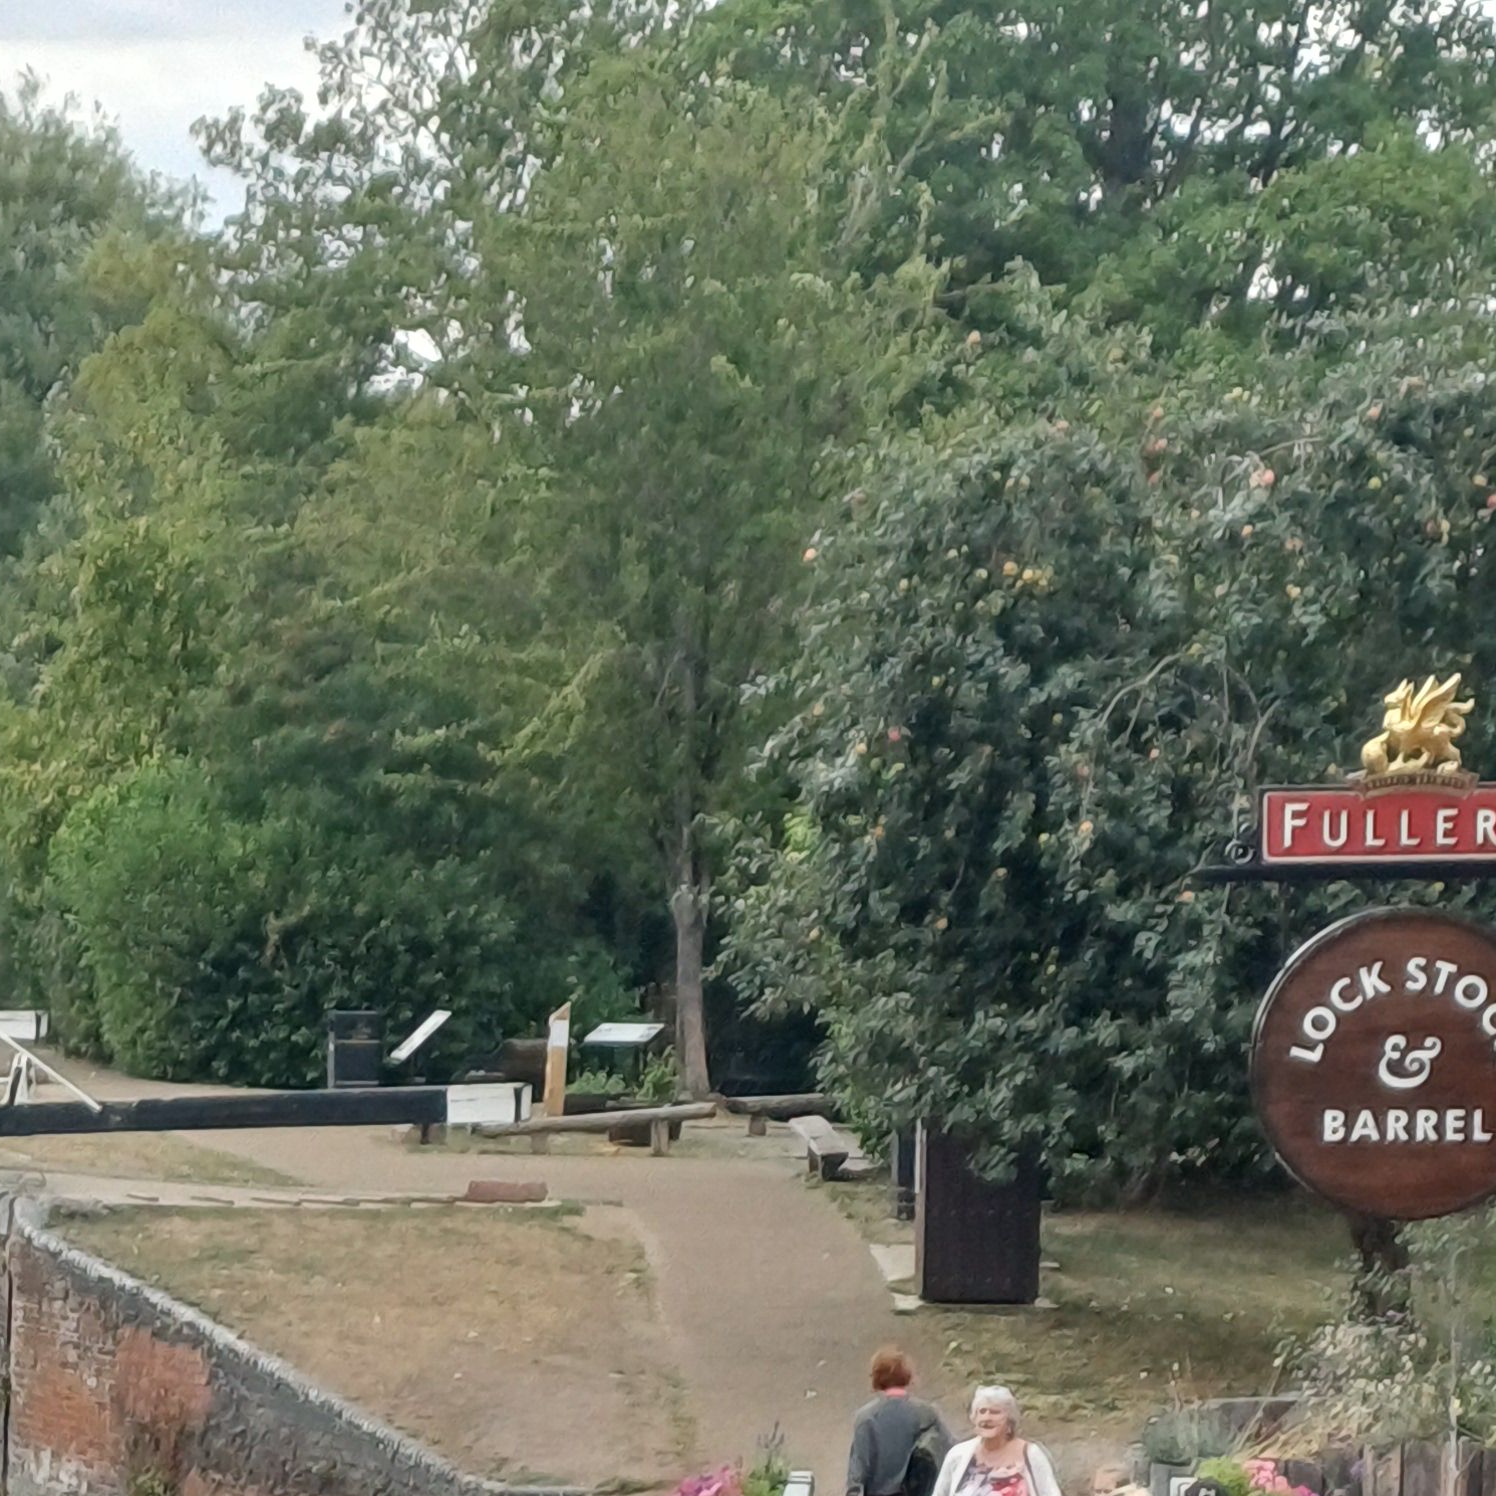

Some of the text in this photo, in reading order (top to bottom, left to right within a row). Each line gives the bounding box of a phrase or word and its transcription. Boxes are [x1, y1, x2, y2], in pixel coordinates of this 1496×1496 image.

[1283, 802, 1496, 849] FULLER
[1289, 960, 1392, 1063] LOCK
[1378, 1034, 1442, 1088] &
[1322, 1108, 1494, 1143] BARREL
